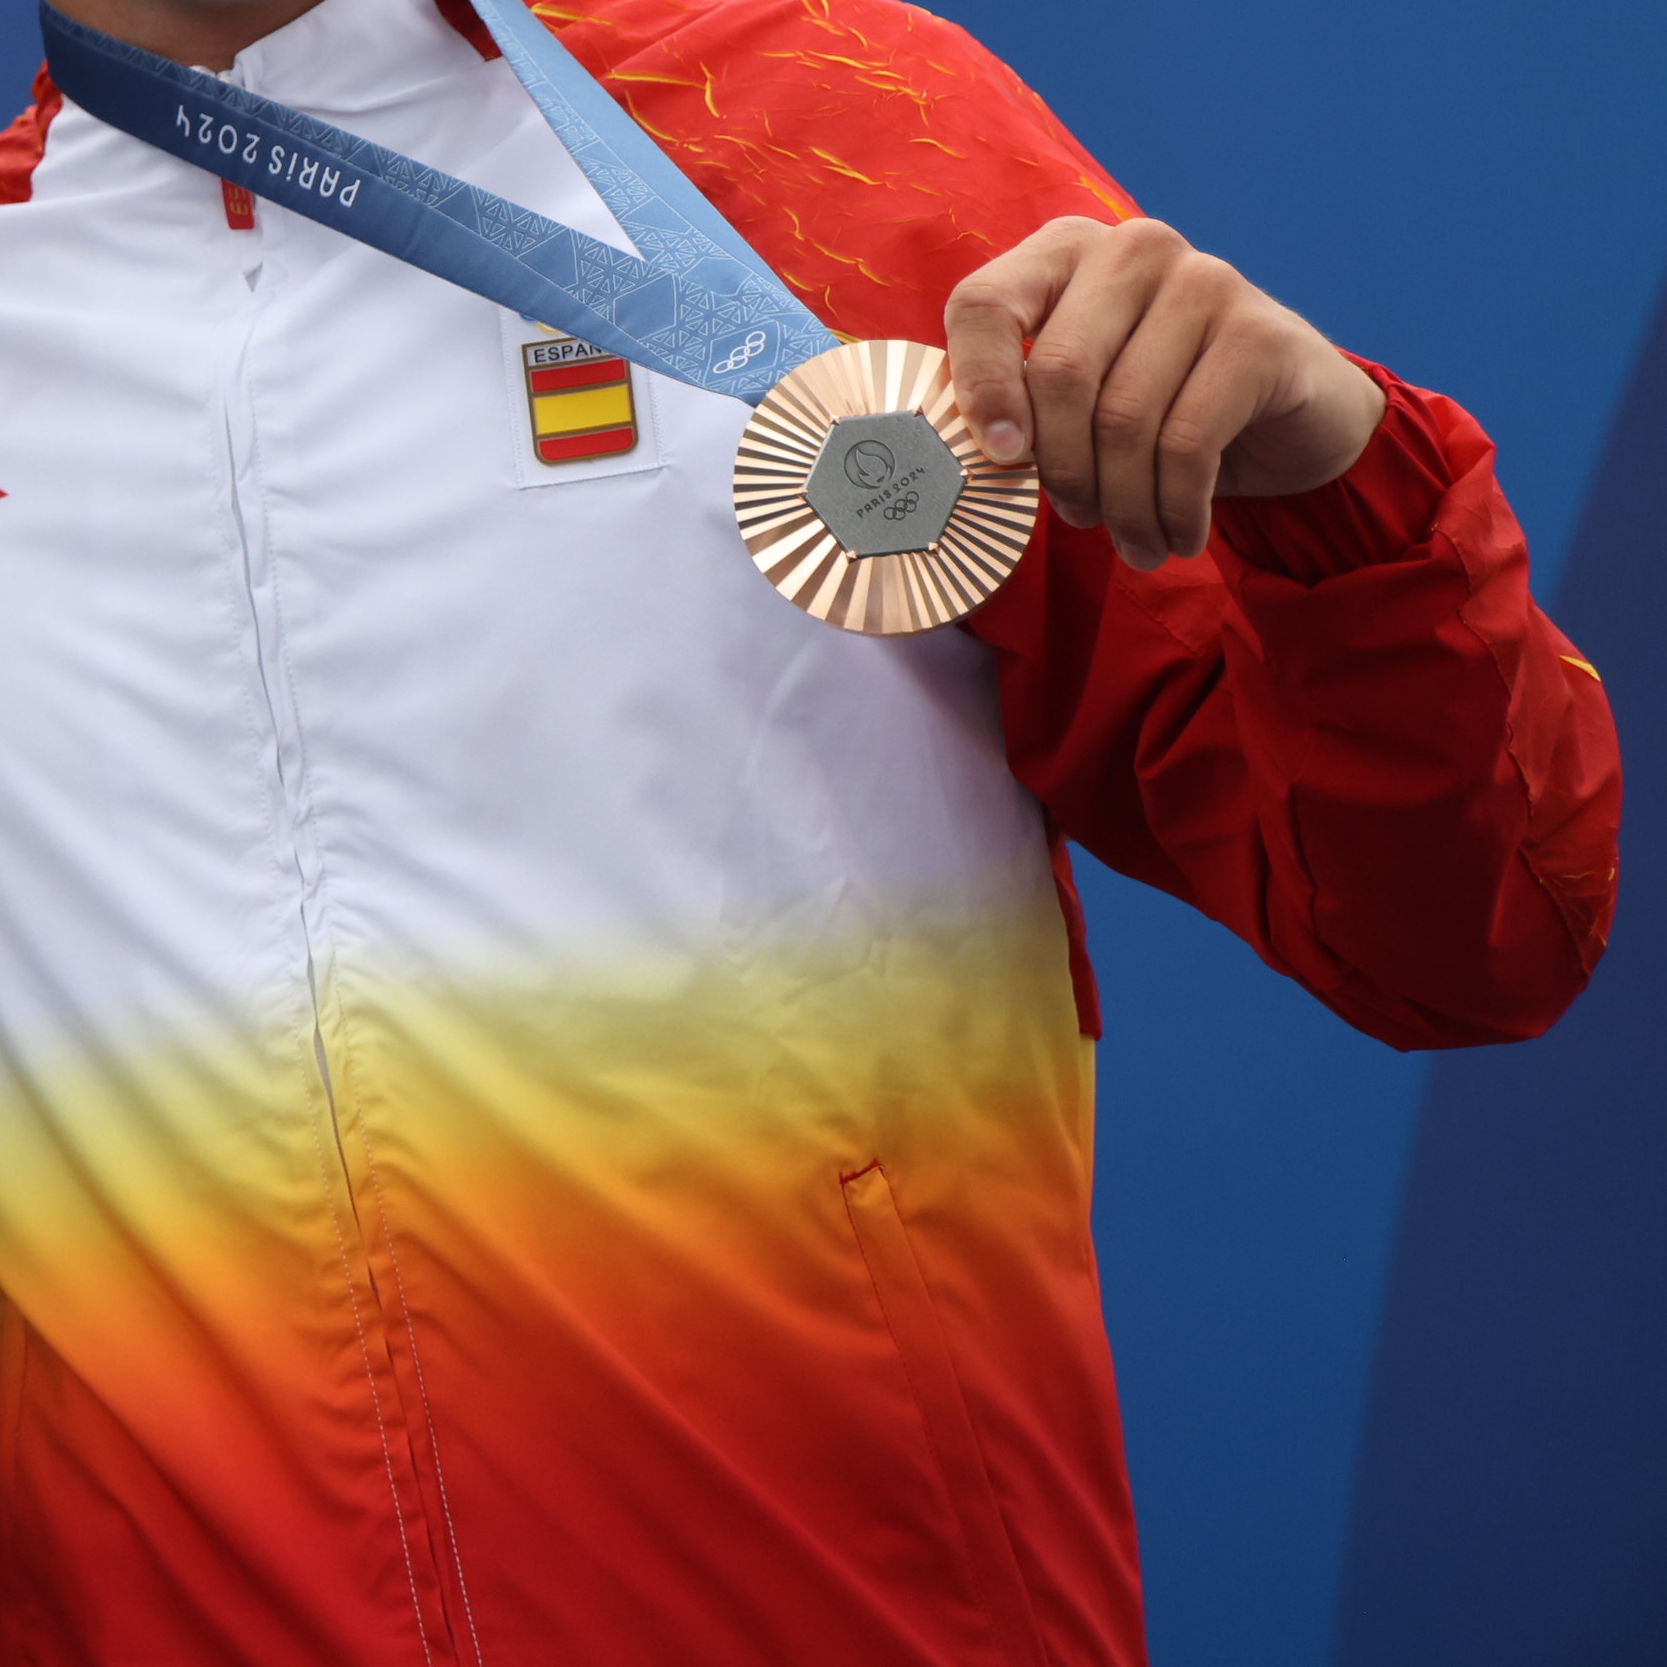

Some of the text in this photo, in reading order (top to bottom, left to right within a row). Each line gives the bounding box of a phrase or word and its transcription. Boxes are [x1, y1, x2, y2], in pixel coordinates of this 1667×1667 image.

[176, 104, 261, 164] 2024
[856, 467, 926, 518] PARIS 2024
